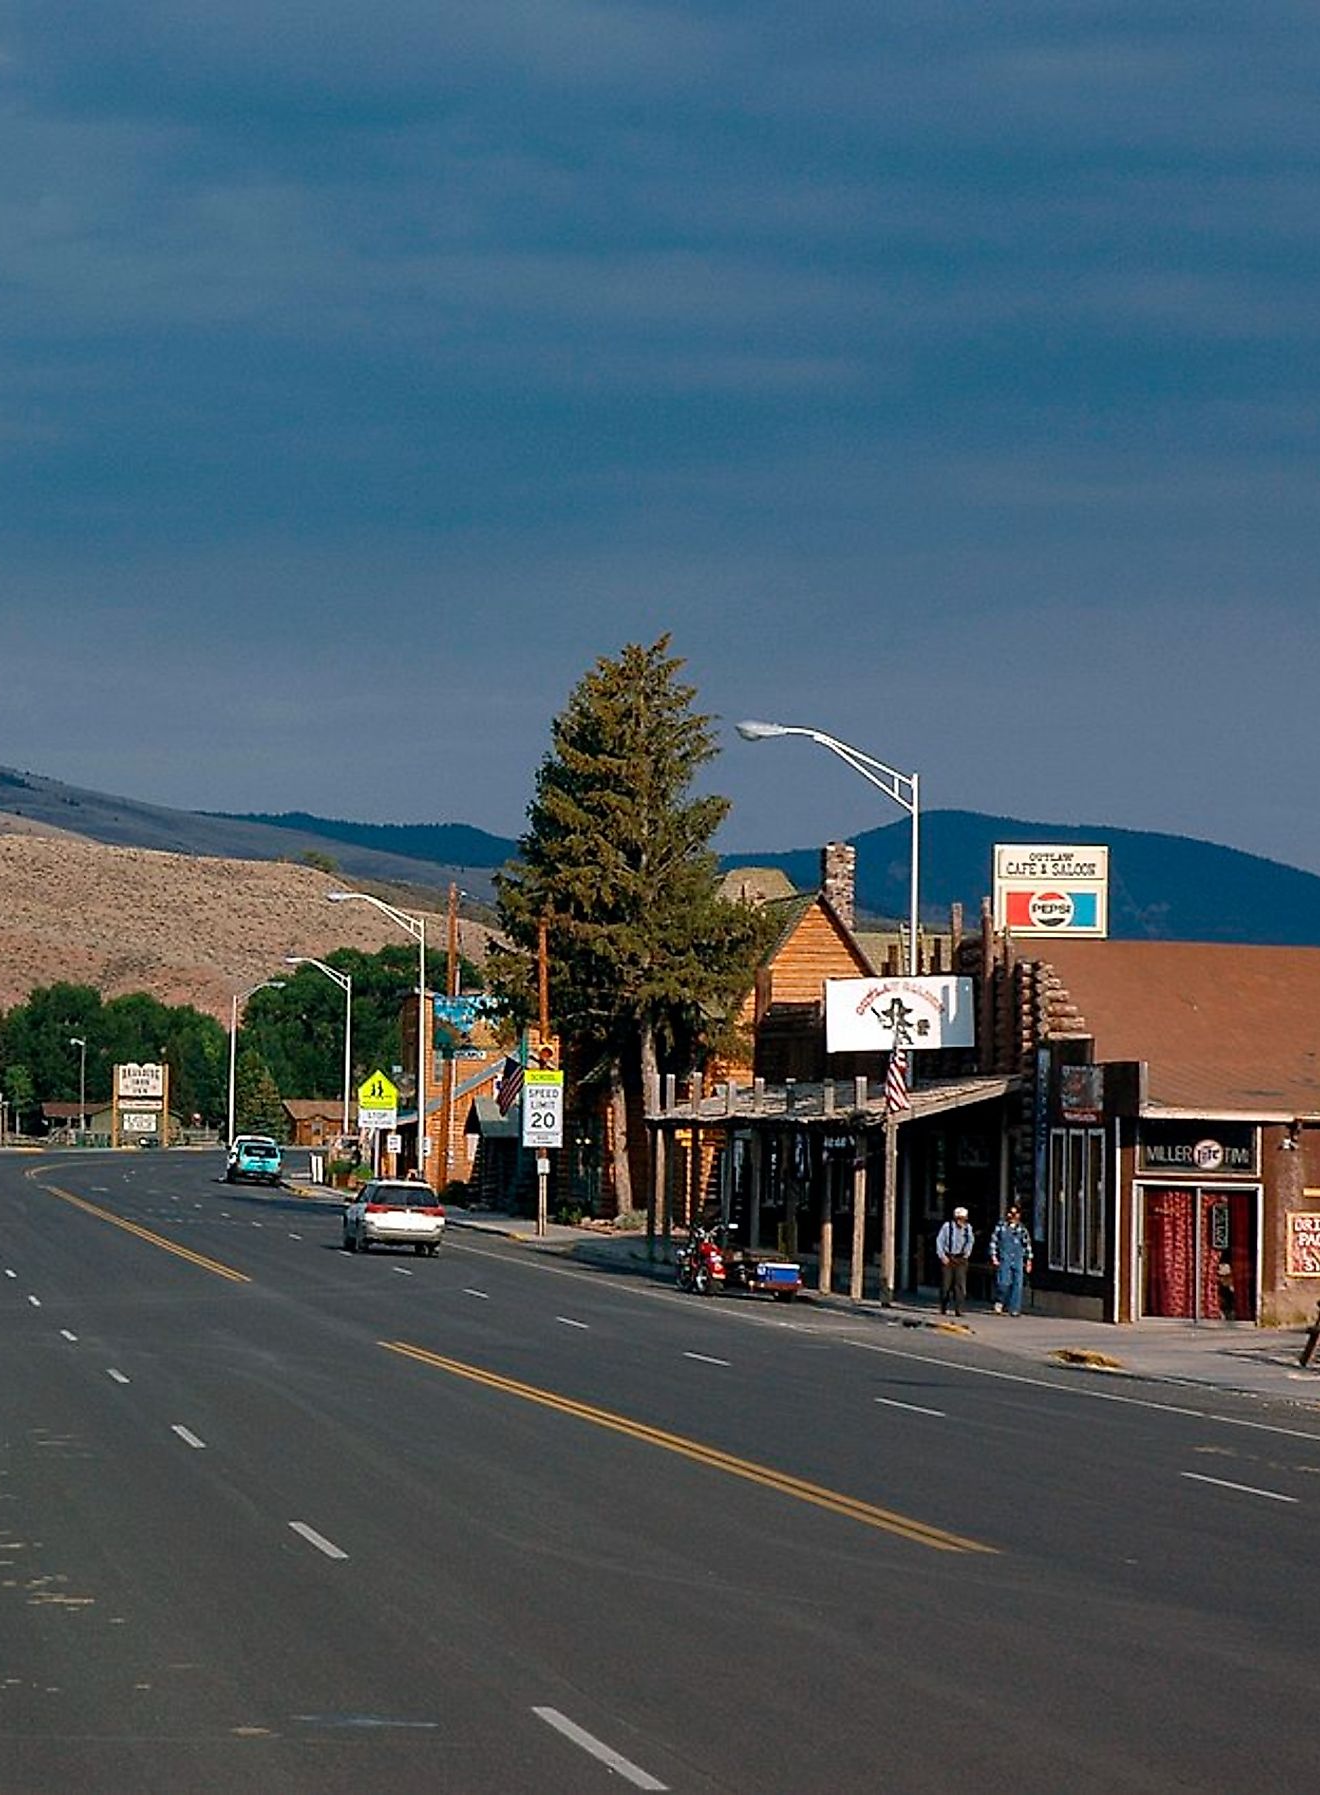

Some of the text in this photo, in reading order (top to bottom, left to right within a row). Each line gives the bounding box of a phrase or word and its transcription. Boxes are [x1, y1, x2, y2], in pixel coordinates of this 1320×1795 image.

[1029, 852, 1075, 862] OUTLAW
[1006, 862, 1037, 876] CAFE
[1052, 862, 1097, 876] SALOON
[1031, 903, 1072, 914] PEPSI
[528, 1088, 559, 1098] SPEED
[530, 1101, 556, 1109] LIMIT
[530, 1111, 556, 1129] 20
[1146, 1145, 1193, 1162] MILLER
